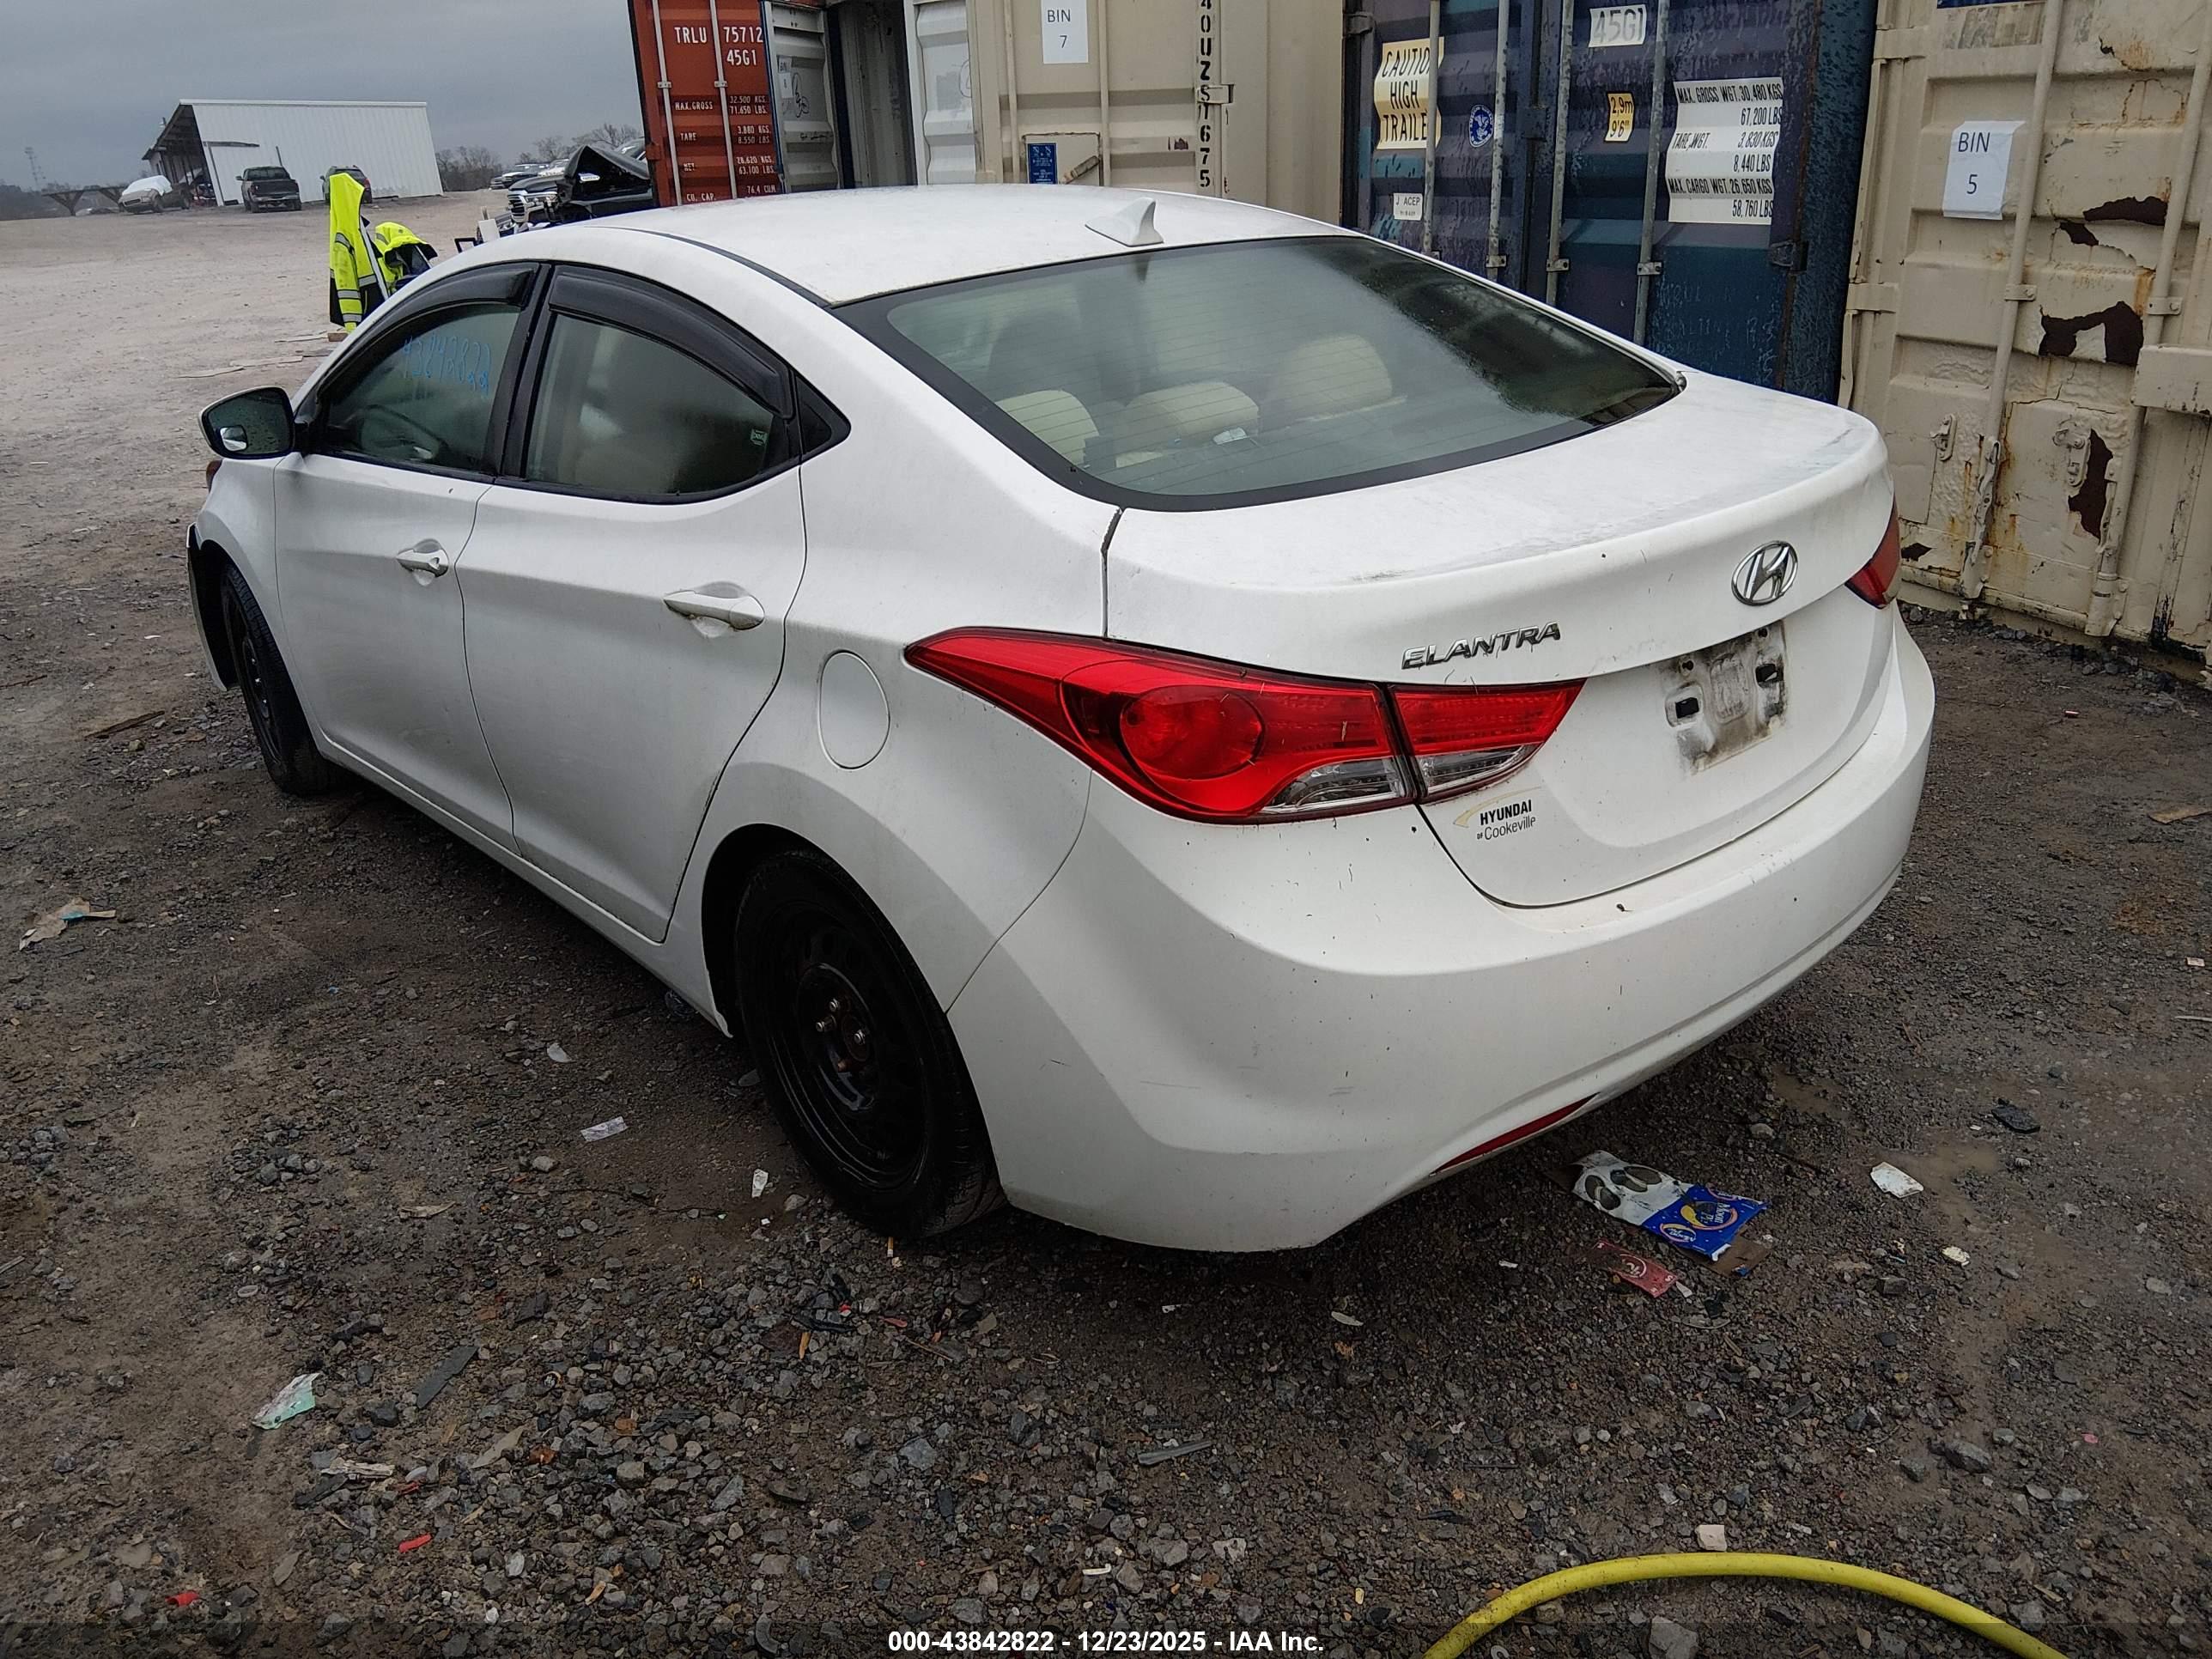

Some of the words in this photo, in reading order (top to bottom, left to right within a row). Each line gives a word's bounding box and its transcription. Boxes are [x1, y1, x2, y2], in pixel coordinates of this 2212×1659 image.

[1047, 9, 1071, 23] BIN
[1593, 7, 1644, 43] 45G1
[674, 27, 708, 44] TRLU
[723, 26, 763, 43] 75712
[1059, 34, 1067, 49] 7
[726, 49, 757, 66] 45G1
[1390, 79, 1419, 110] HIGH
[1676, 87, 1696, 103] MAX.
[1695, 86, 1720, 103] GROSS
[1766, 82, 1784, 100] KGS
[1610, 96, 1633, 117] 2,9m
[1741, 106, 1767, 126] 67,200
[1767, 106, 1783, 125] LBS
[680, 132, 698, 142] TARE
[1382, 112, 1429, 143] TRAILE
[1759, 131, 1779, 148] KGS
[1958, 131, 1991, 153] BIN
[1733, 154, 1756, 173] 8,440
[1755, 153, 1771, 173] LBS
[1668, 178, 1686, 194] MAX.
[1686, 178, 1710, 194] CARGO
[1755, 178, 1773, 194] KGS
[1966, 173, 1978, 195] 5
[1732, 198, 1759, 218] 58,760
[1759, 198, 1774, 218] LBS
[1401, 622, 1562, 670] ELANTRA
[1480, 799, 1533, 826] HYUNDAI
[1484, 814, 1537, 841] Cookeville
